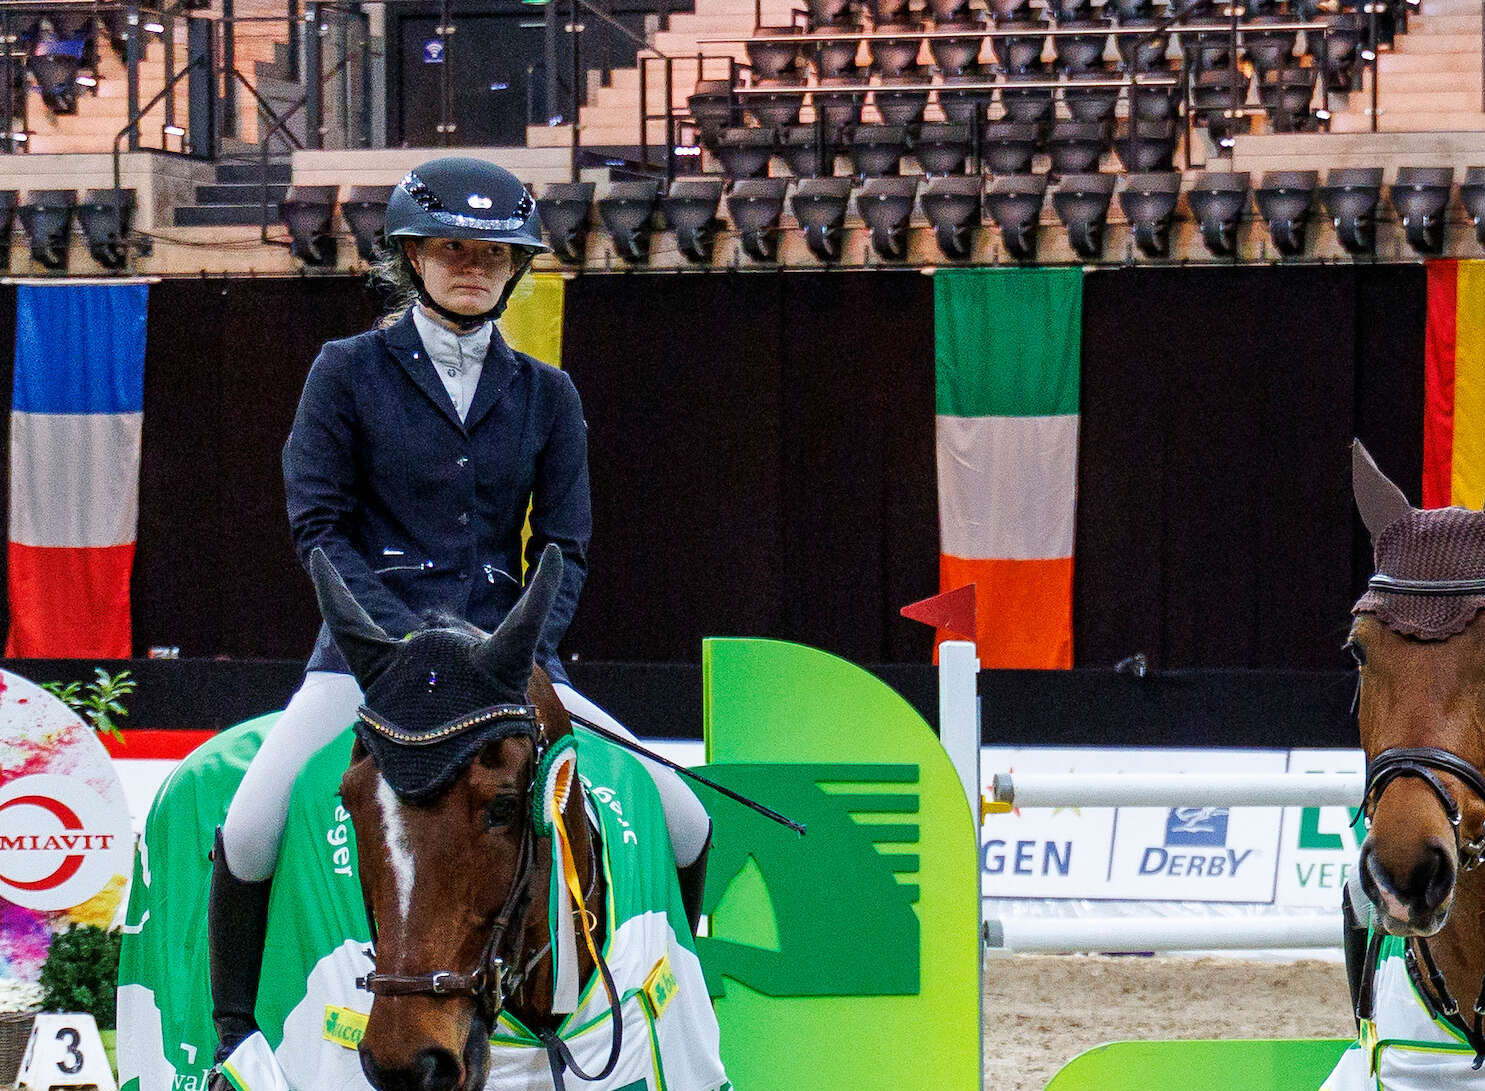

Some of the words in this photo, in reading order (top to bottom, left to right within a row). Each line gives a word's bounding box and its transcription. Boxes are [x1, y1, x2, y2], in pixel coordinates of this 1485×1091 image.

[0, 834, 114, 850] MIAVIT
[1138, 847, 1252, 878] DERBY
[55, 1027, 84, 1074] 3
